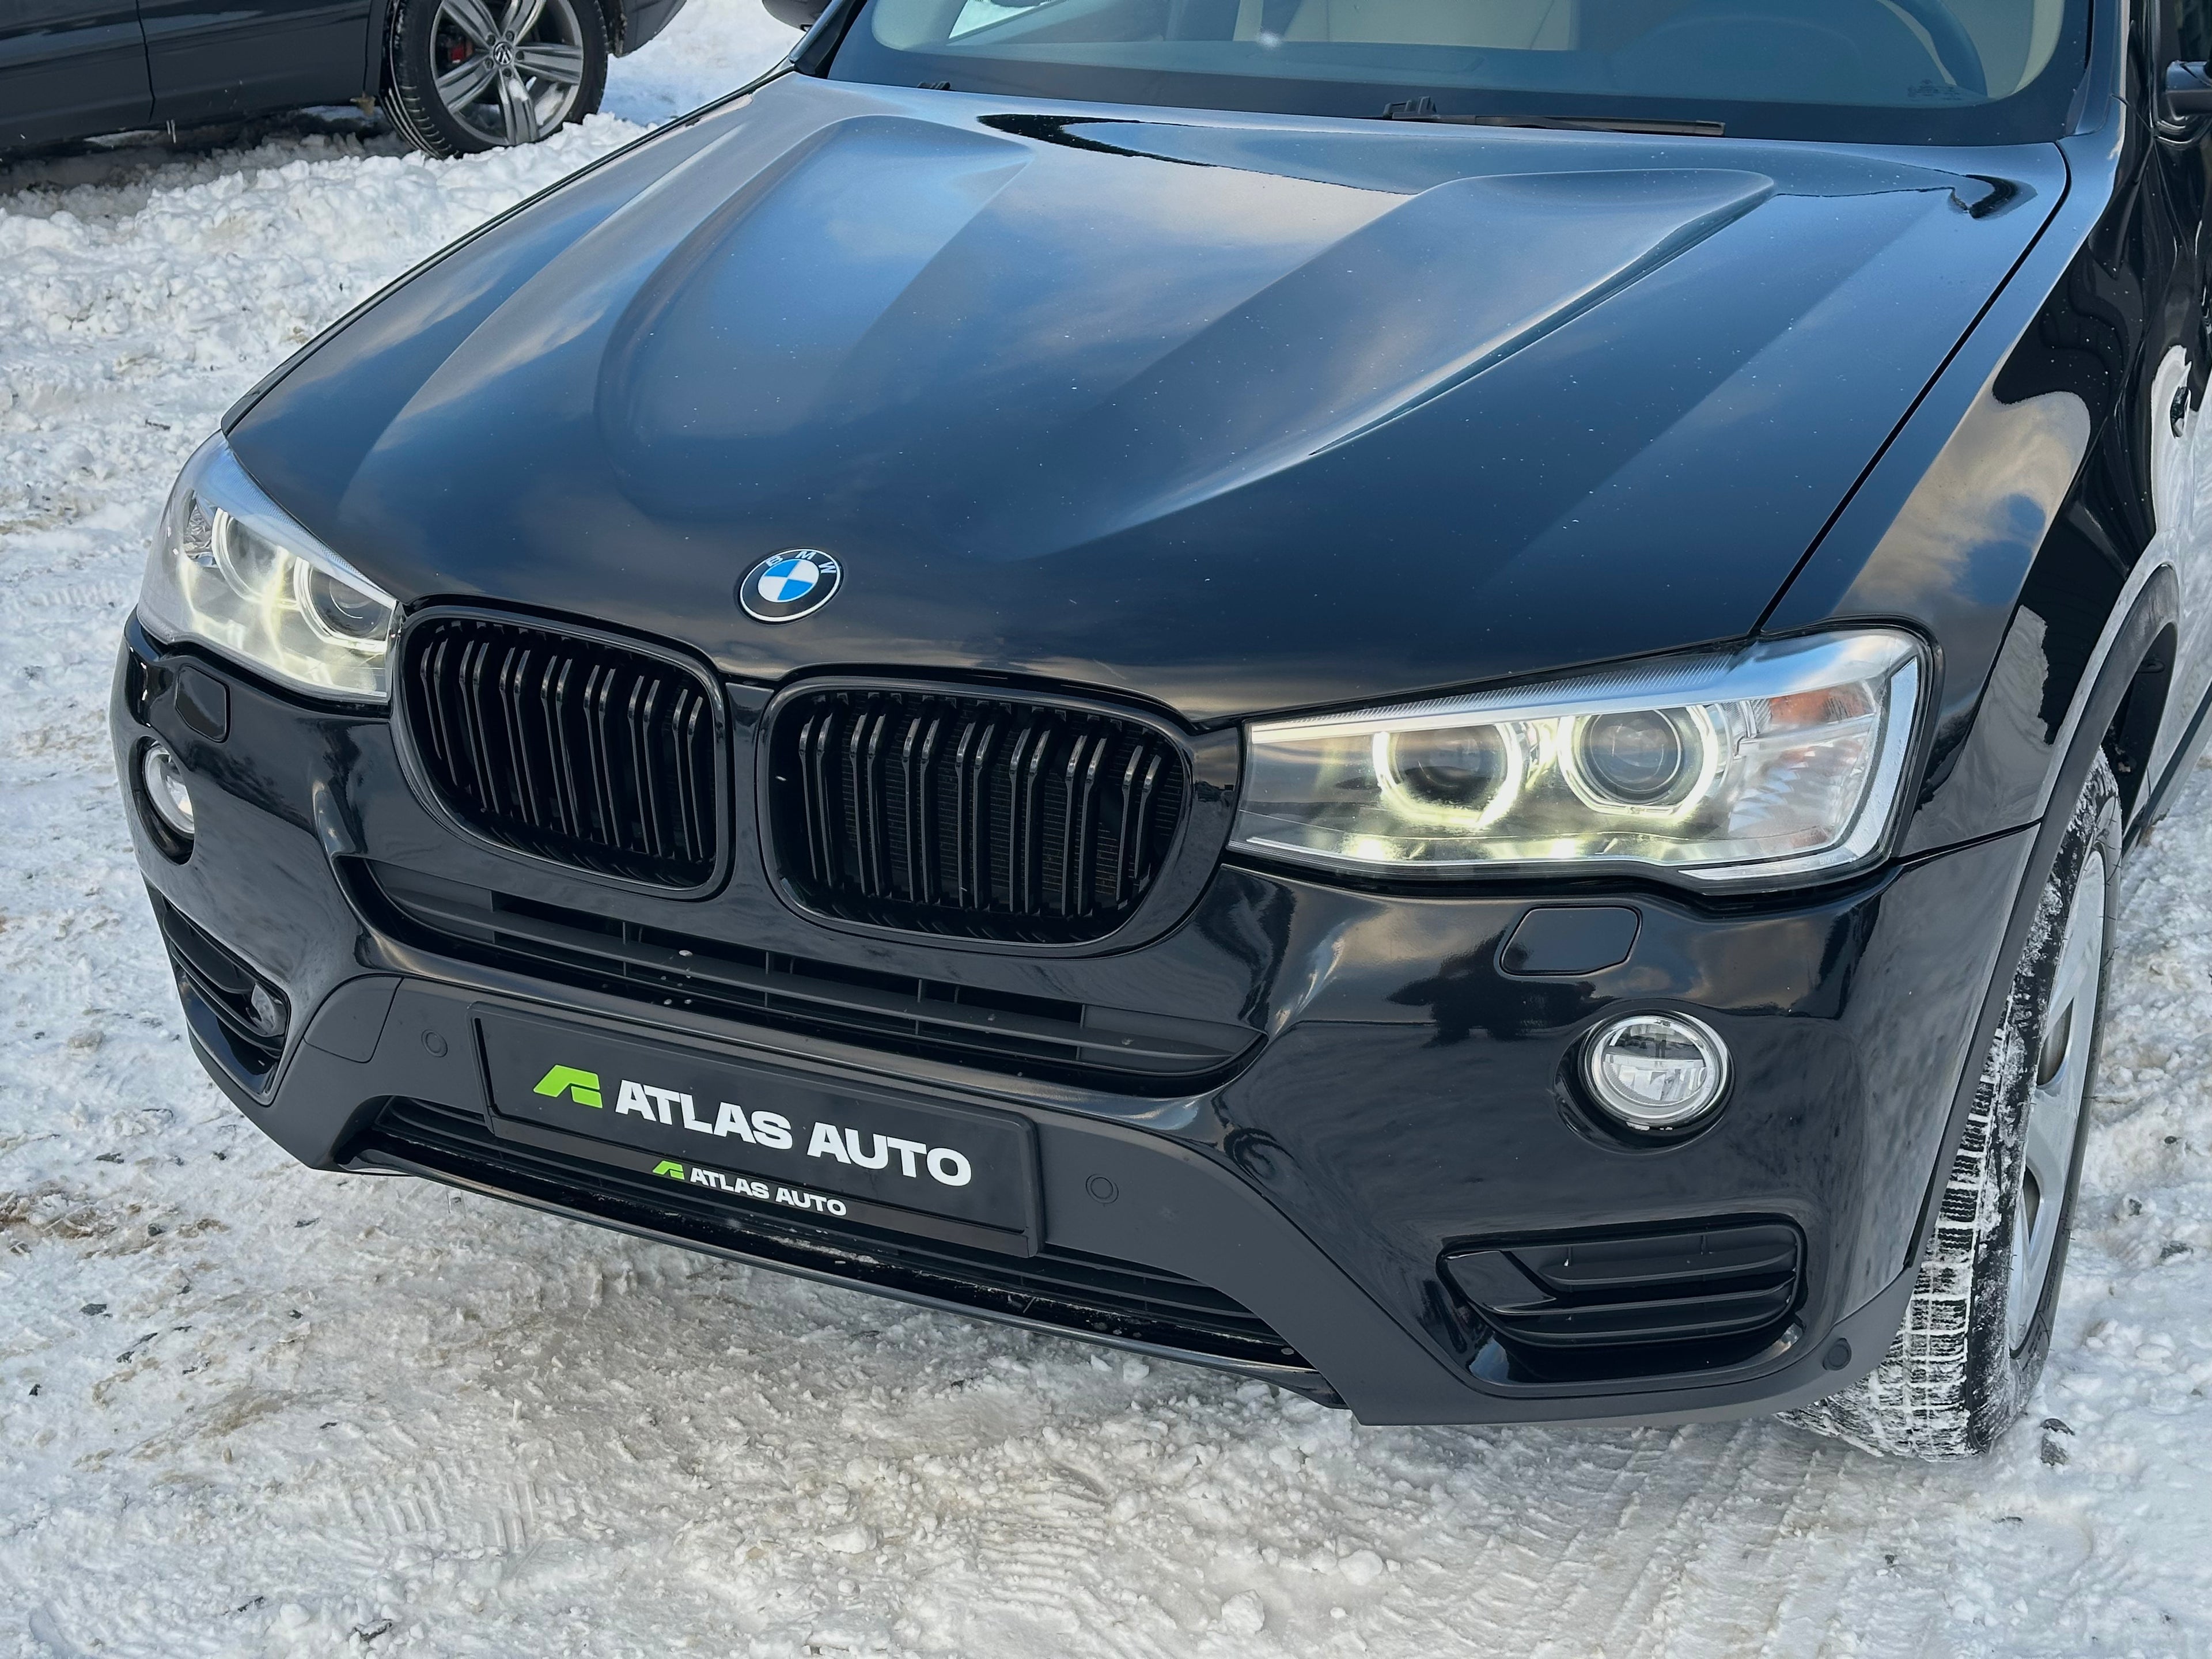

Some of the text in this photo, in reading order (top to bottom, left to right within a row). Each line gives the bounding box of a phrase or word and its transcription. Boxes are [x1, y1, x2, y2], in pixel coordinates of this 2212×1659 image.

[765, 550, 836, 574] BMW
[615, 1080, 972, 1187] ATLAS AUTO
[690, 1167, 847, 1216] ATLAS AUTO
